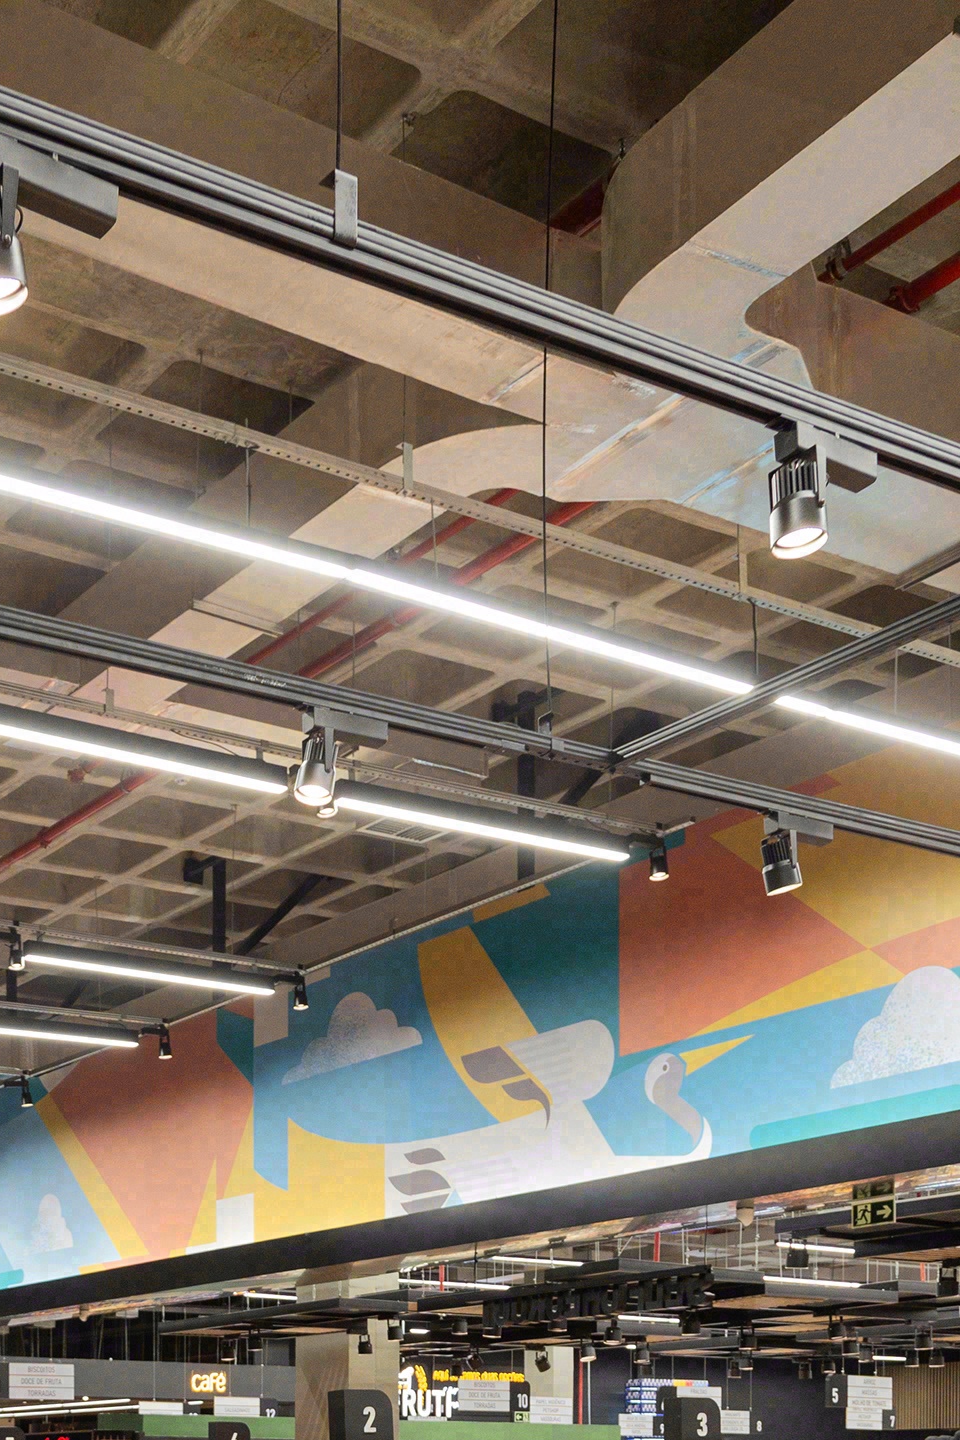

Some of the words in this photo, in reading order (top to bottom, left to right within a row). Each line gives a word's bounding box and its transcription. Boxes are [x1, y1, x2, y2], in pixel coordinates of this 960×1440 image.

[27, 1365, 56, 1373] BISCOITOS
[21, 1377, 36, 1385] DOCE
[36, 1377, 44, 1385] DE
[44, 1377, 63, 1385] FRUTA
[191, 1371, 227, 1393] café
[27, 1389, 57, 1397] TORRADAS
[831, 1387, 839, 1404] 5
[517, 1393, 529, 1409] 10
[265, 1408, 276, 1418] 12
[362, 1405, 377, 1434] 2
[696, 1412, 709, 1437] 3
[756, 1420, 763, 1432] 8
[889, 1415, 896, 1428] 7
